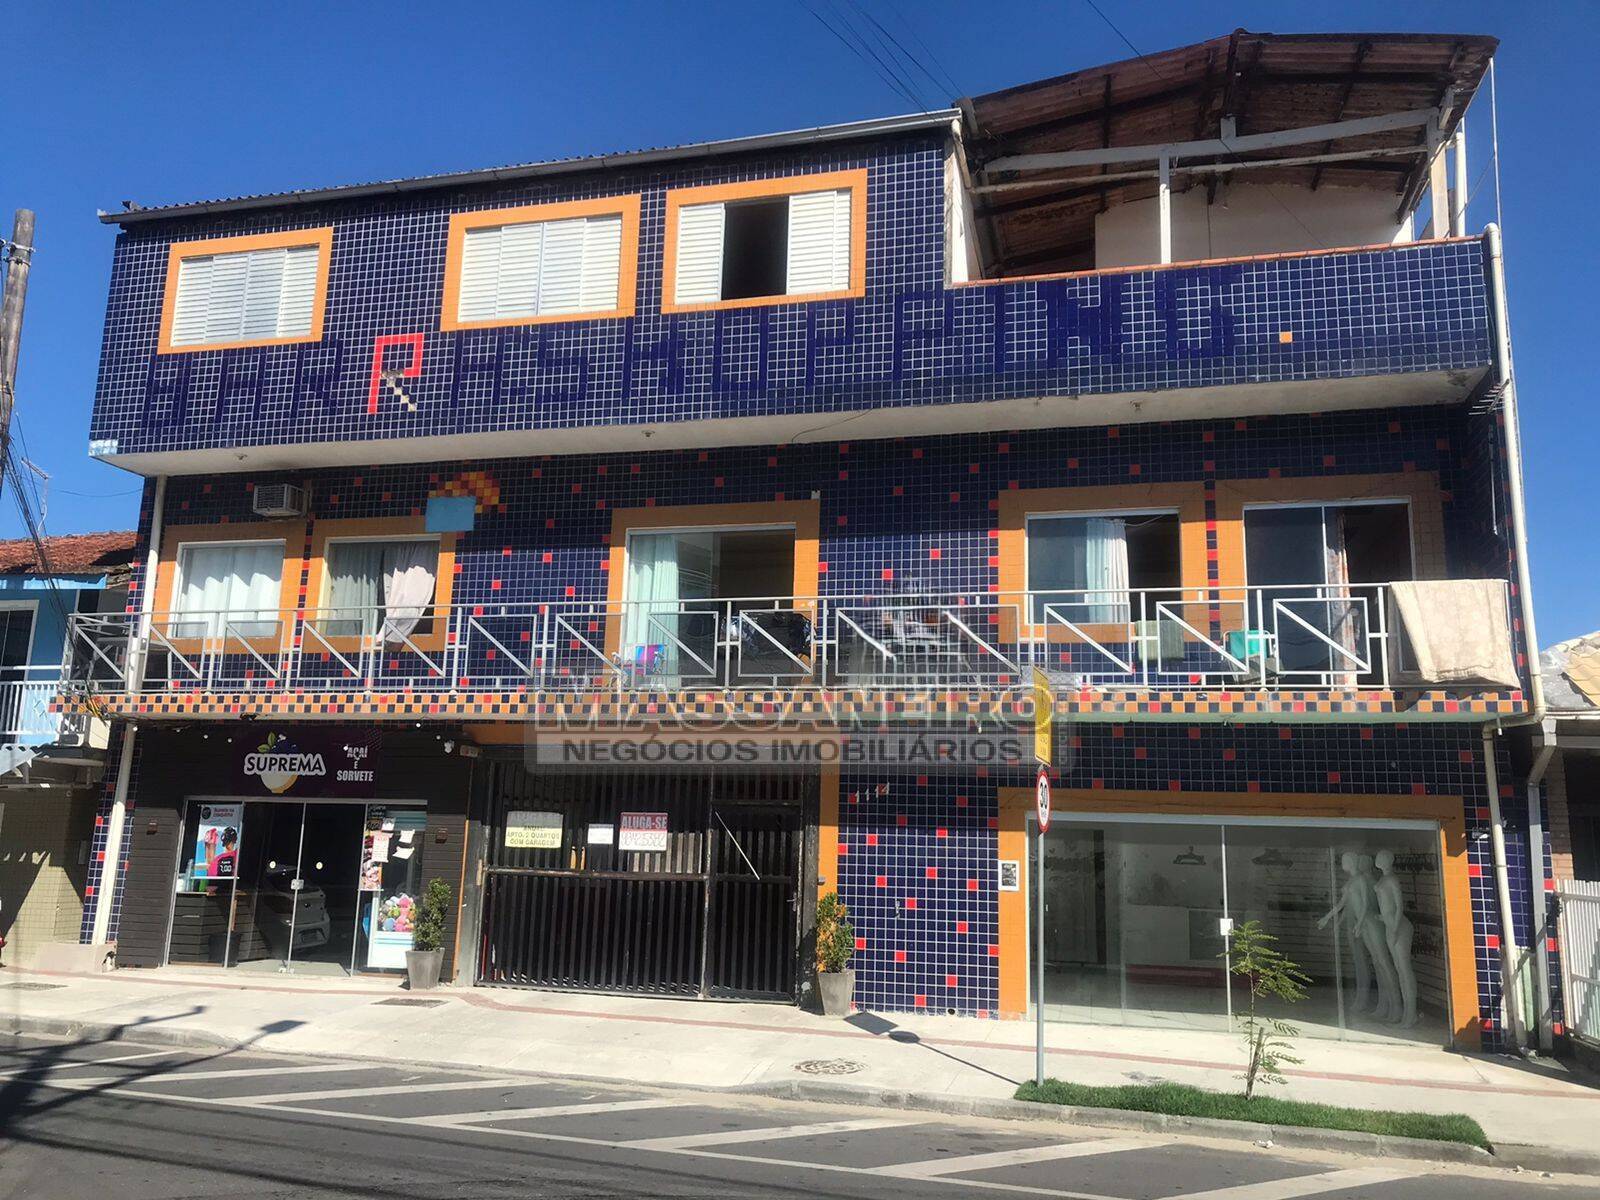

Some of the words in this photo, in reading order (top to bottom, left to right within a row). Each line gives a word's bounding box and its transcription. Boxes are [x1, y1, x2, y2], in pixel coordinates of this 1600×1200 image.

[246, 755, 324, 773] SUPREMA
[337, 770, 374, 781] SORVETE
[1040, 782, 1049, 809] 30
[622, 816, 668, 829] ALUGA-SE
